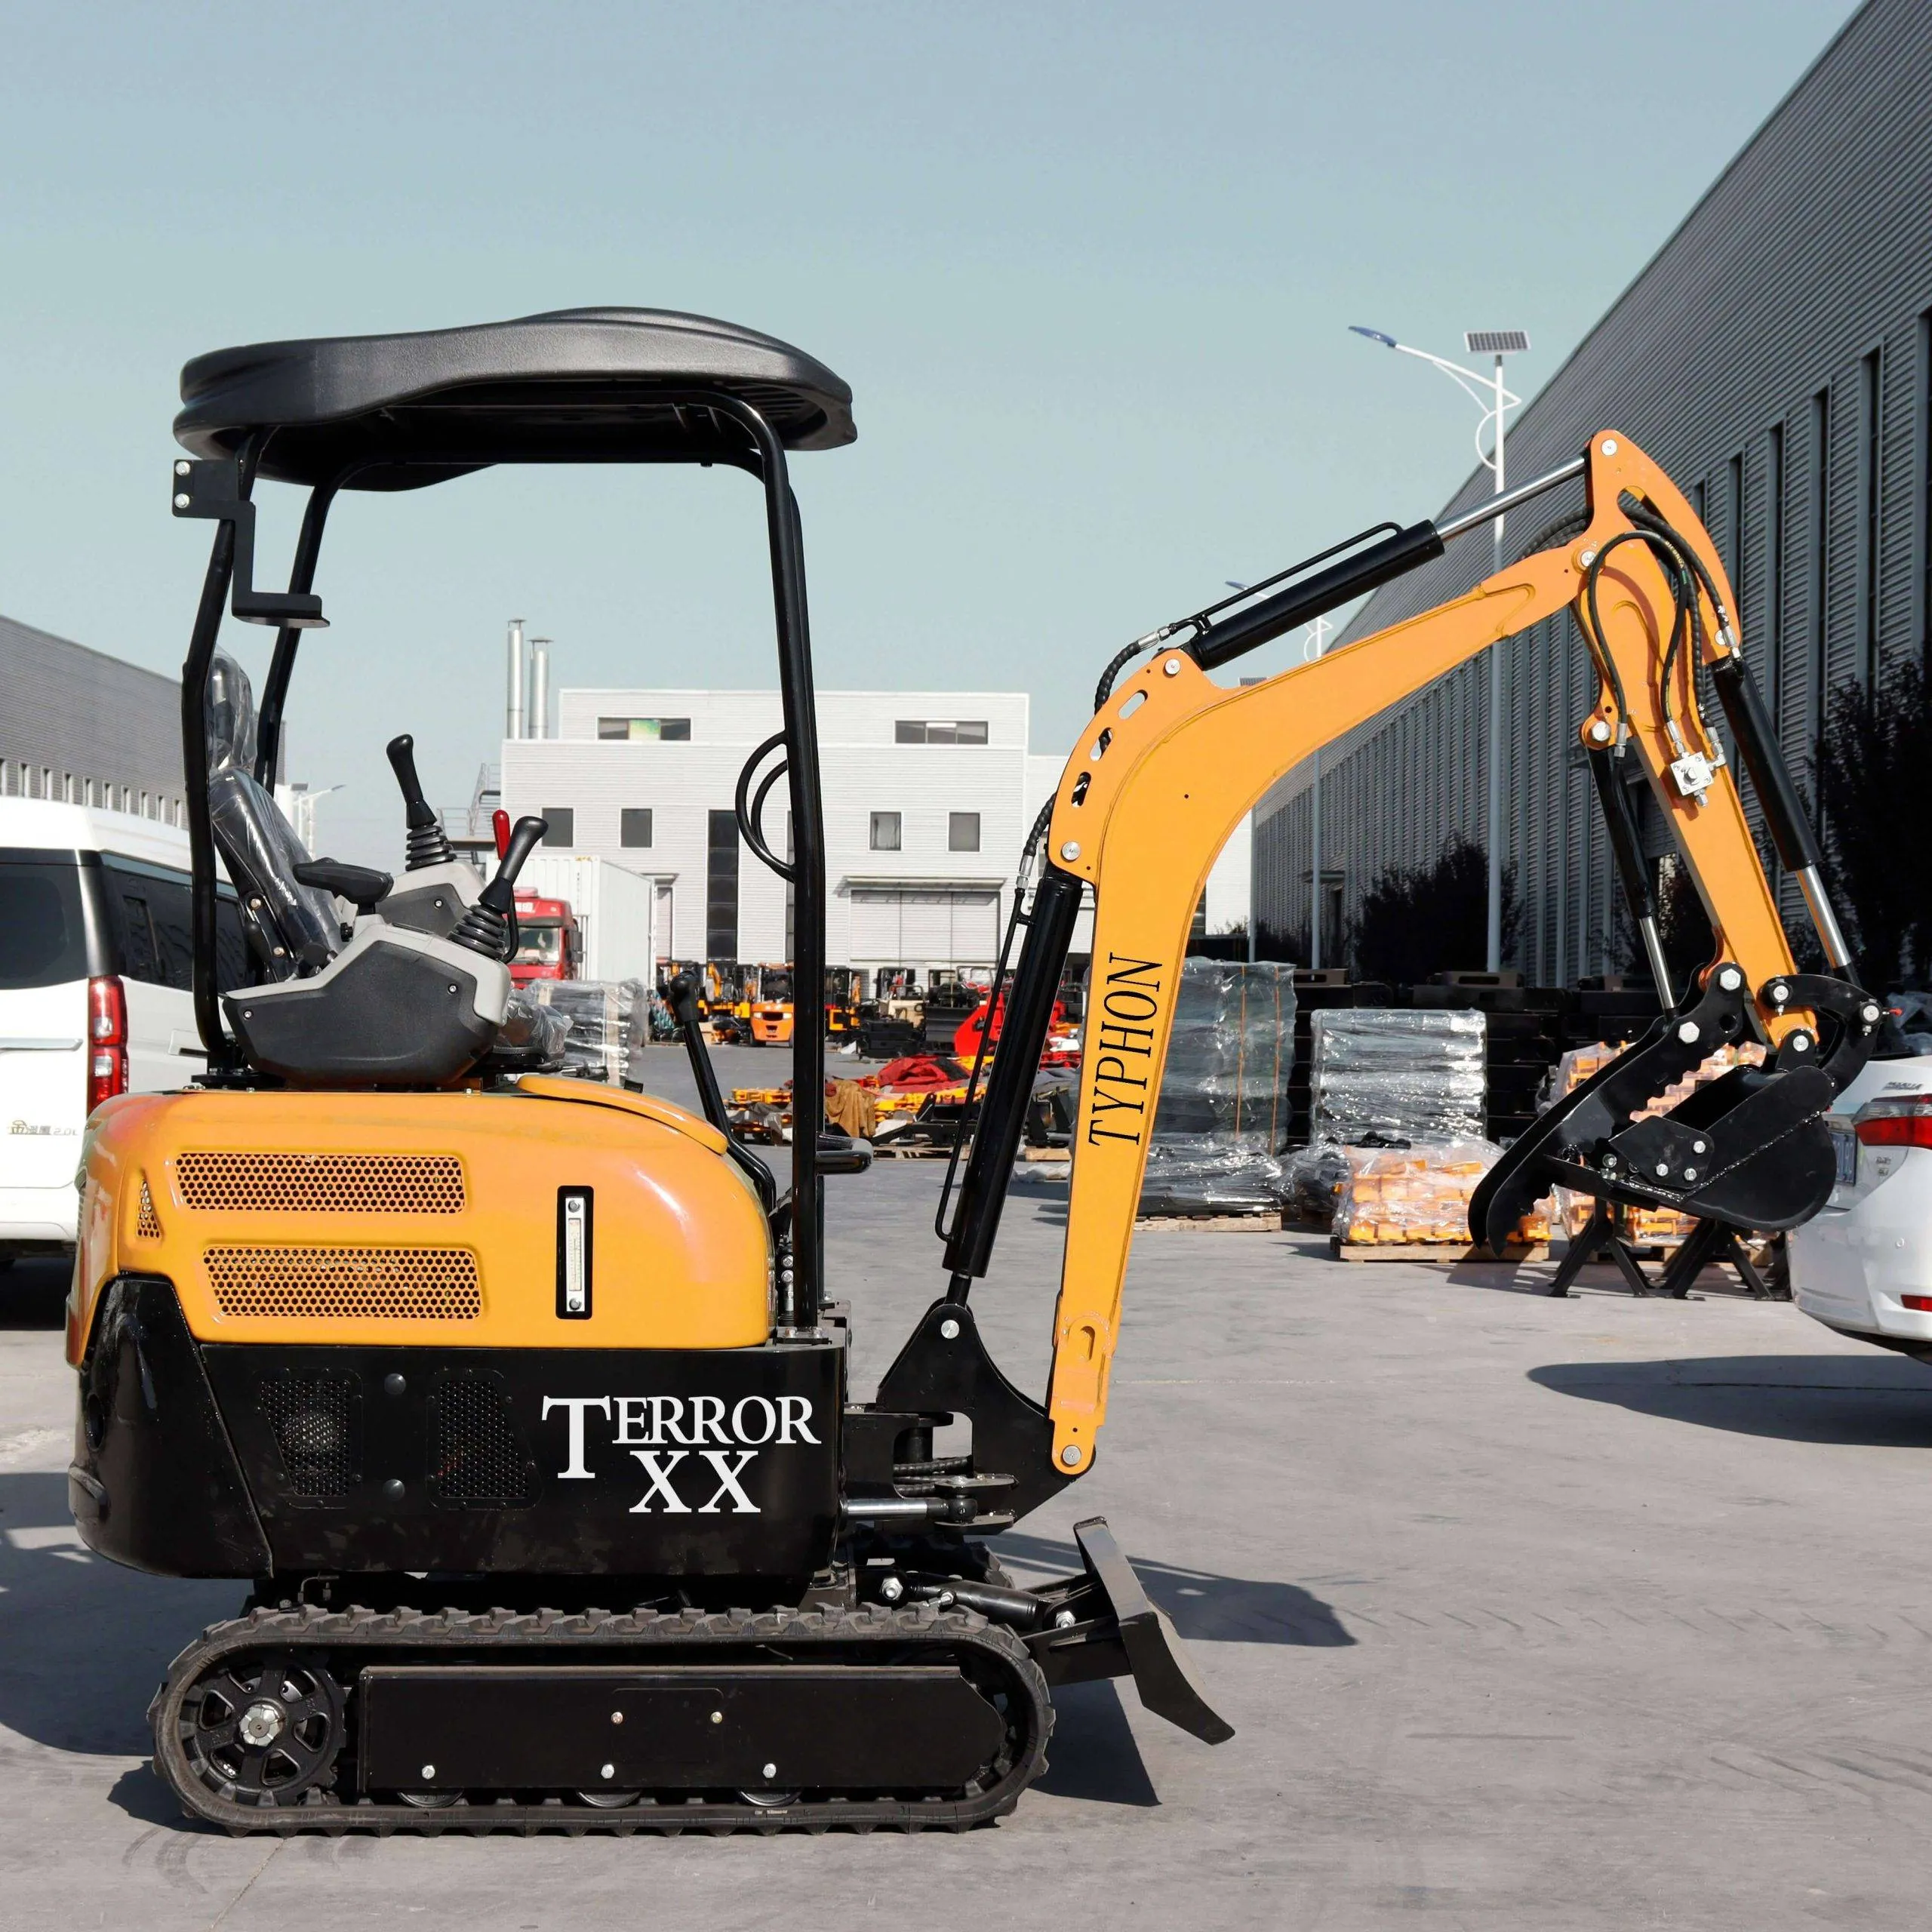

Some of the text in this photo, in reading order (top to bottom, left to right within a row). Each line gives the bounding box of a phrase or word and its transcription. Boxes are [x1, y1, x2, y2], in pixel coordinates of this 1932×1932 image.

[1088, 952, 1163, 1146] TYPHON
[541, 1395, 822, 1478] TERROR
[629, 1451, 761, 1513] XX
